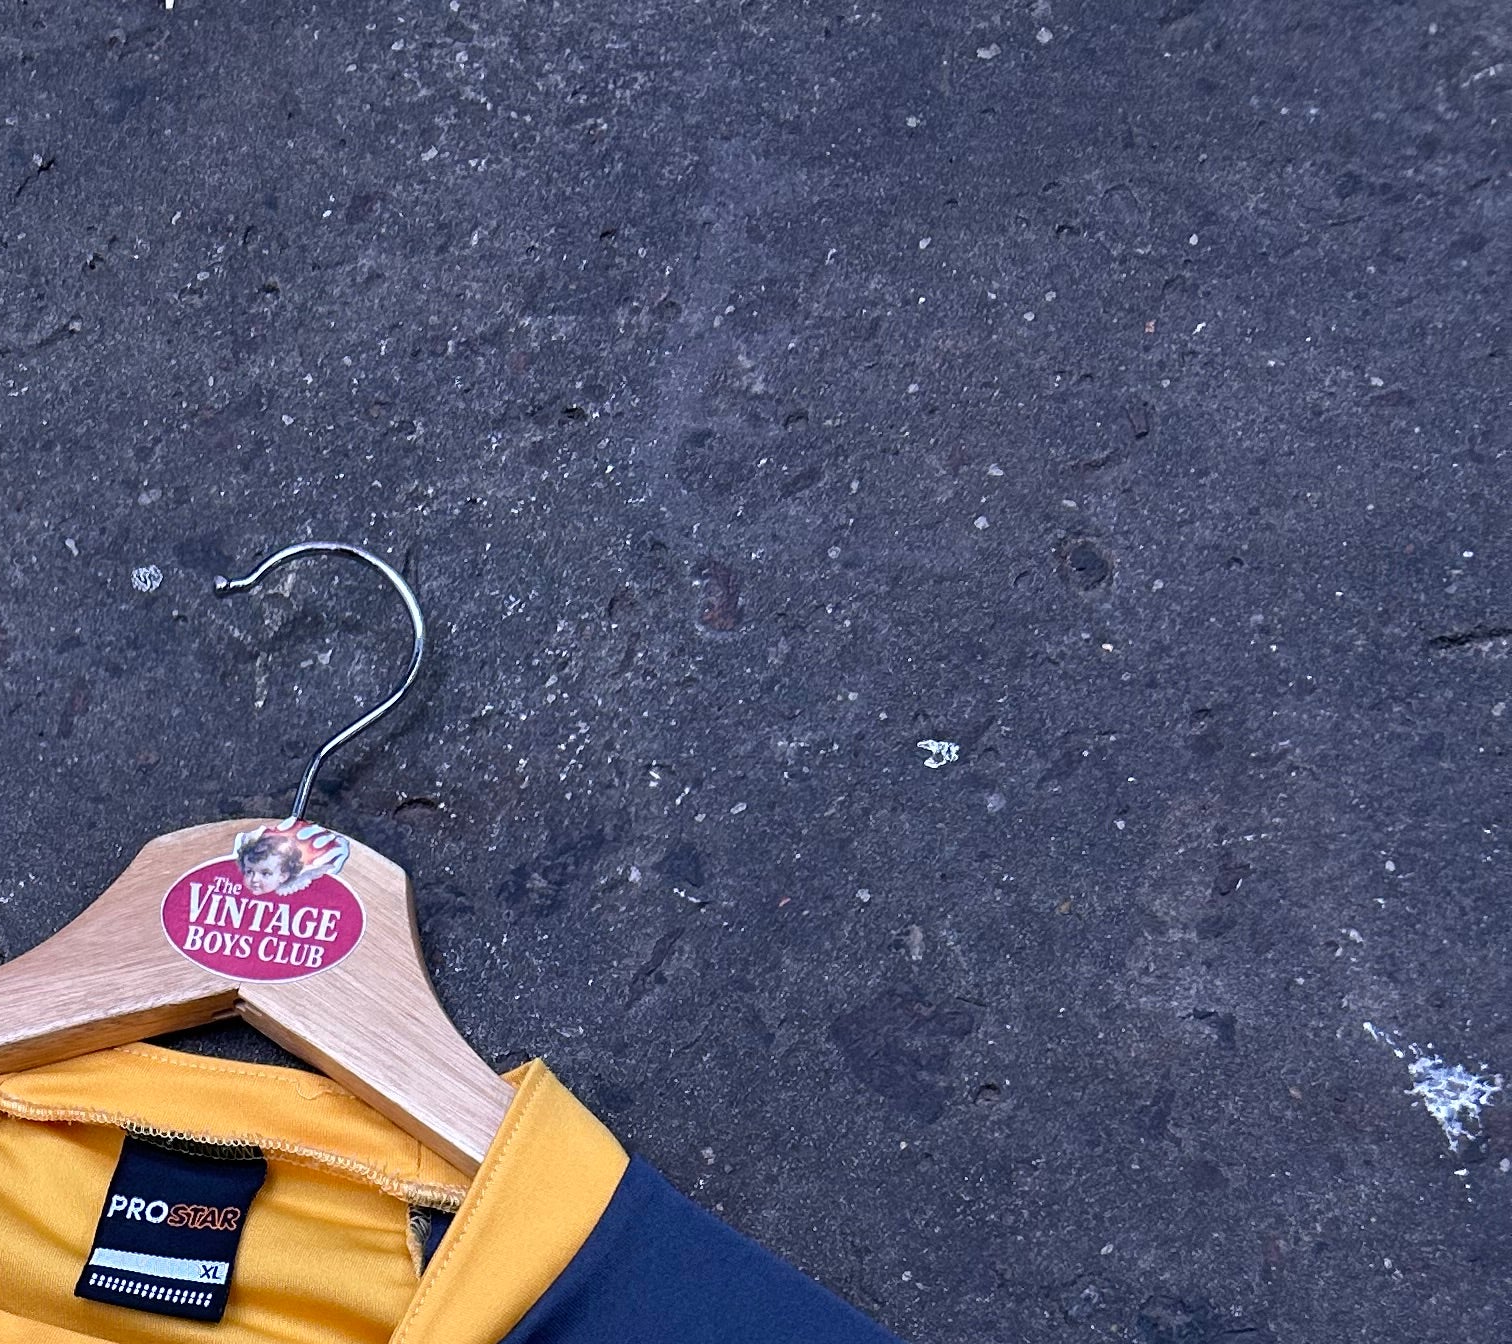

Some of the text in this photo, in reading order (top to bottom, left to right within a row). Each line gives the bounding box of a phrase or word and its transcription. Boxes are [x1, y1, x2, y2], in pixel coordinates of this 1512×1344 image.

[213, 876, 242, 895] The
[189, 882, 341, 942] VINTAGE
[183, 925, 325, 968] BOYS CLUB
[107, 1194, 241, 1230] PROSTAR
[200, 1264, 220, 1280] XL
